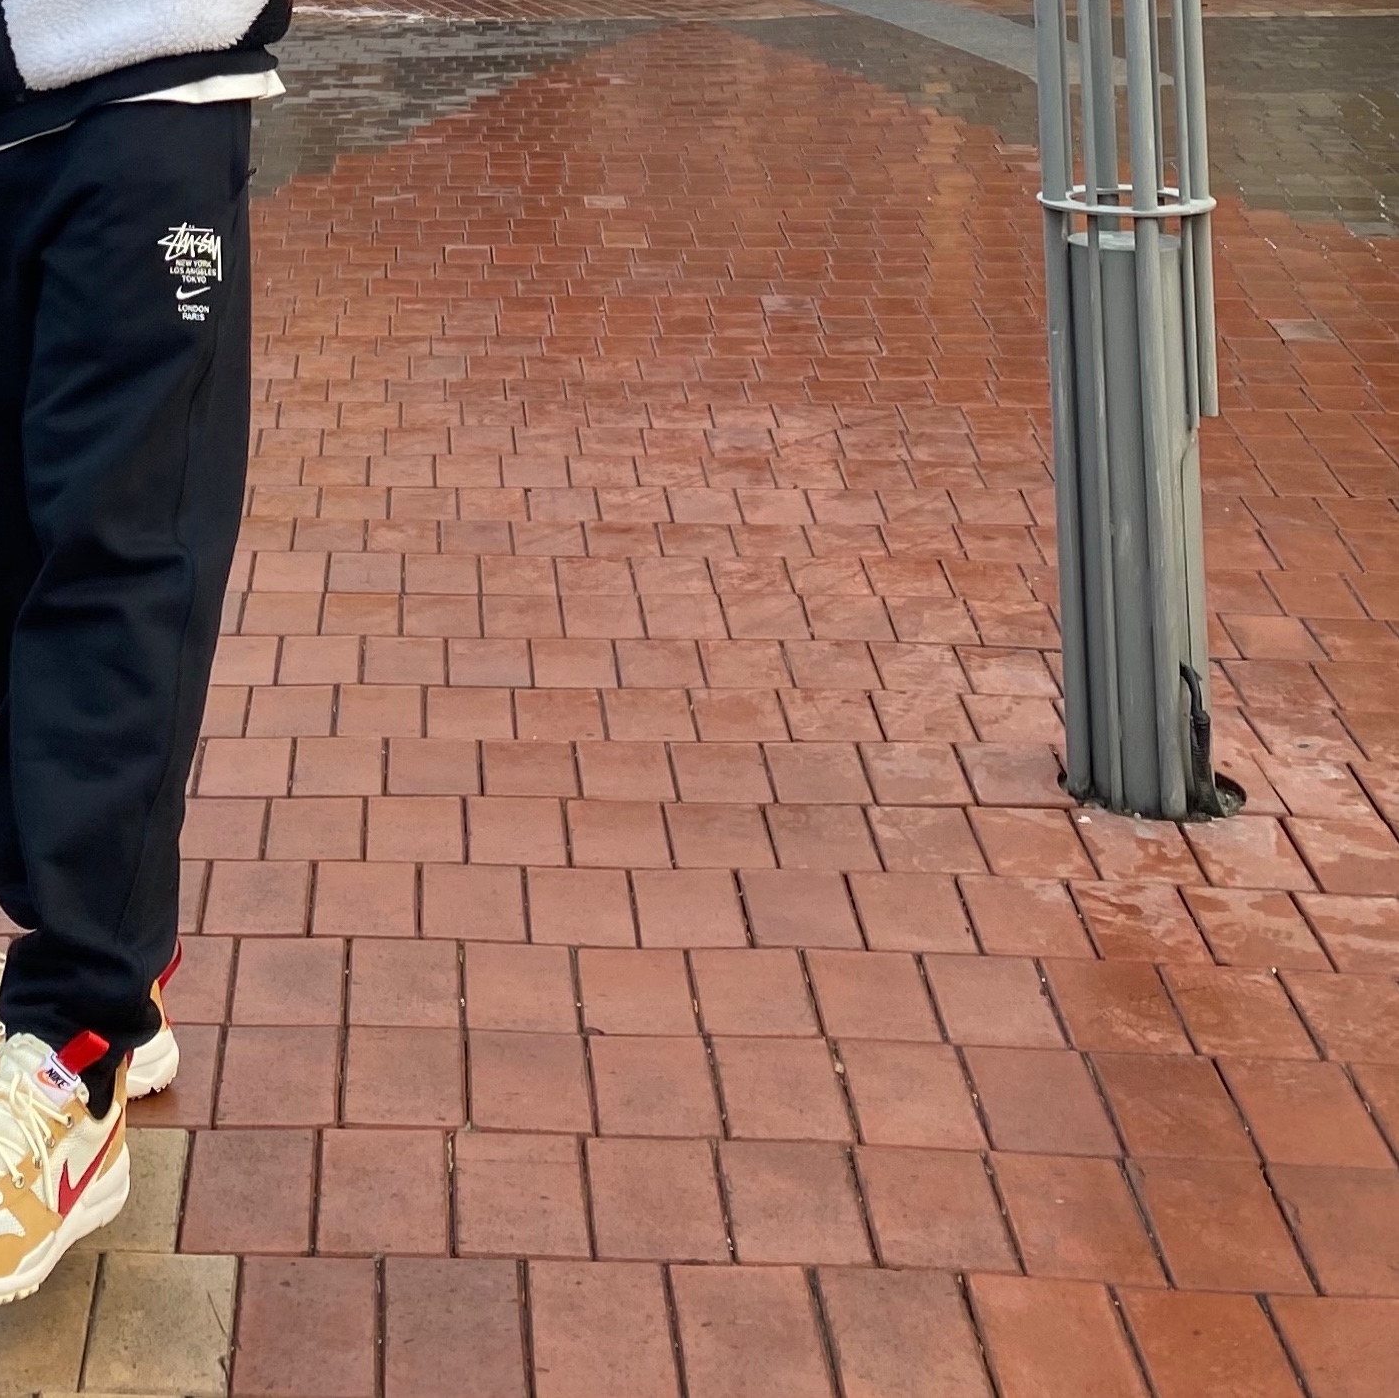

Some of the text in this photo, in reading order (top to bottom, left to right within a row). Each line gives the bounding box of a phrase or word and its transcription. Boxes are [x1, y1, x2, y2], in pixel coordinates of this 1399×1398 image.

[175, 259, 212, 268] NEW YORK
[169, 266, 217, 276] LOS ANGELES
[181, 274, 207, 284] TOKYO
[177, 304, 210, 313] LONDON
[182, 312, 205, 321] PARIS
[46, 1067, 71, 1090] NIKE
